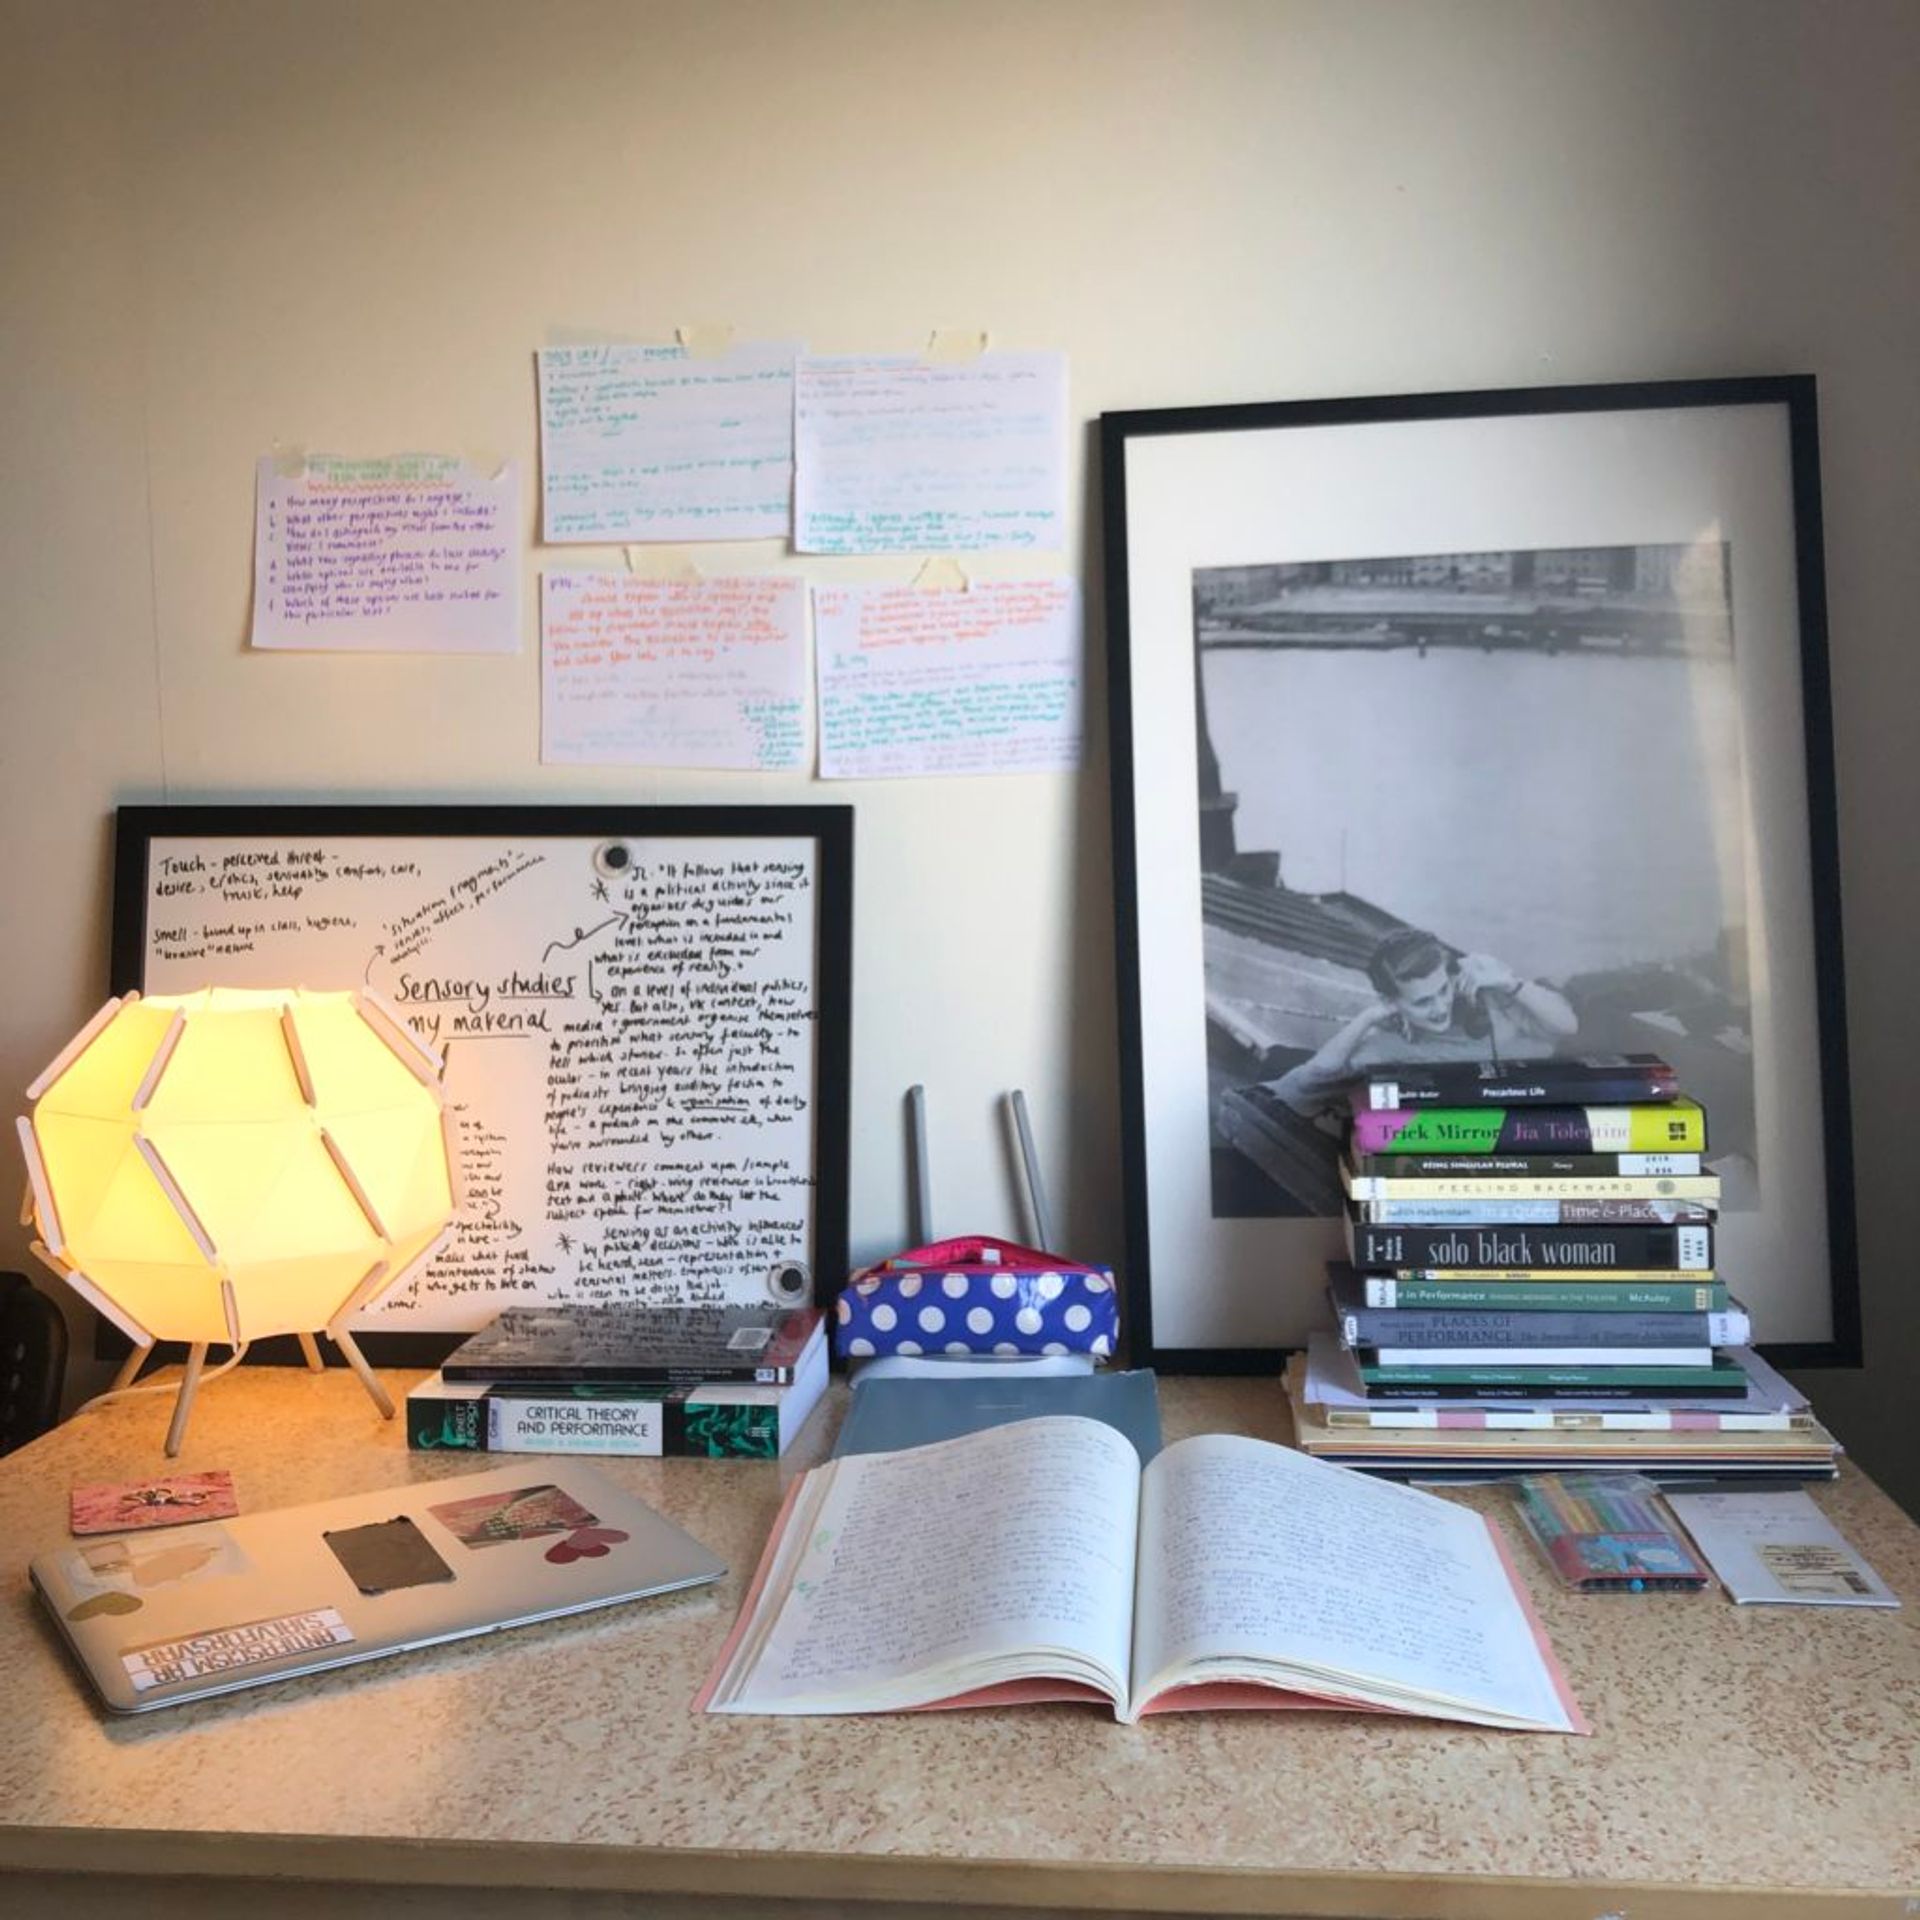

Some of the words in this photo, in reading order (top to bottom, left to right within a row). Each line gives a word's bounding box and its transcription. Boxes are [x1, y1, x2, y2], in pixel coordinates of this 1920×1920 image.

[160, 856, 206, 877] Touch
[222, 851, 281, 868] perceived
[731, 861, 758, 875] that
[272, 883, 304, 900] help
[655, 882, 706, 900] political
[394, 972, 490, 1013] Sensory
[497, 970, 577, 999] studies
[453, 1008, 552, 1034] material
[564, 1019, 603, 1033] media
[1482, 1086, 1526, 1097] Precarious
[1530, 1086, 1546, 1097] Life
[1378, 1124, 1429, 1141] Trick
[1436, 1123, 1502, 1141] Mirror
[1513, 1122, 1540, 1141] Jia
[547, 1161, 574, 1174] How
[582, 1160, 648, 1173] reviewers
[1423, 1161, 1449, 1170] BEING
[1450, 1161, 1493, 1170] SINGULAR
[1495, 1161, 1529, 1170] PLURAL
[1438, 1184, 1518, 1193] FEELING
[1534, 1183, 1632, 1192] BACKWARD
[1561, 1204, 1599, 1219] Time
[1429, 1232, 1469, 1265] solo
[1479, 1232, 1533, 1265] black
[1542, 1241, 1616, 1265] woman
[1419, 1289, 1485, 1300] Performance
[1432, 1316, 1489, 1328] PLACES
[1493, 1316, 1512, 1327] OF
[1399, 1331, 1512, 1343] PERFORMANCE
[525, 1406, 582, 1420] CRITICAL
[587, 1407, 638, 1421] THEORY
[516, 1421, 545, 1434] AND
[550, 1421, 649, 1437] PERFORMANCE
